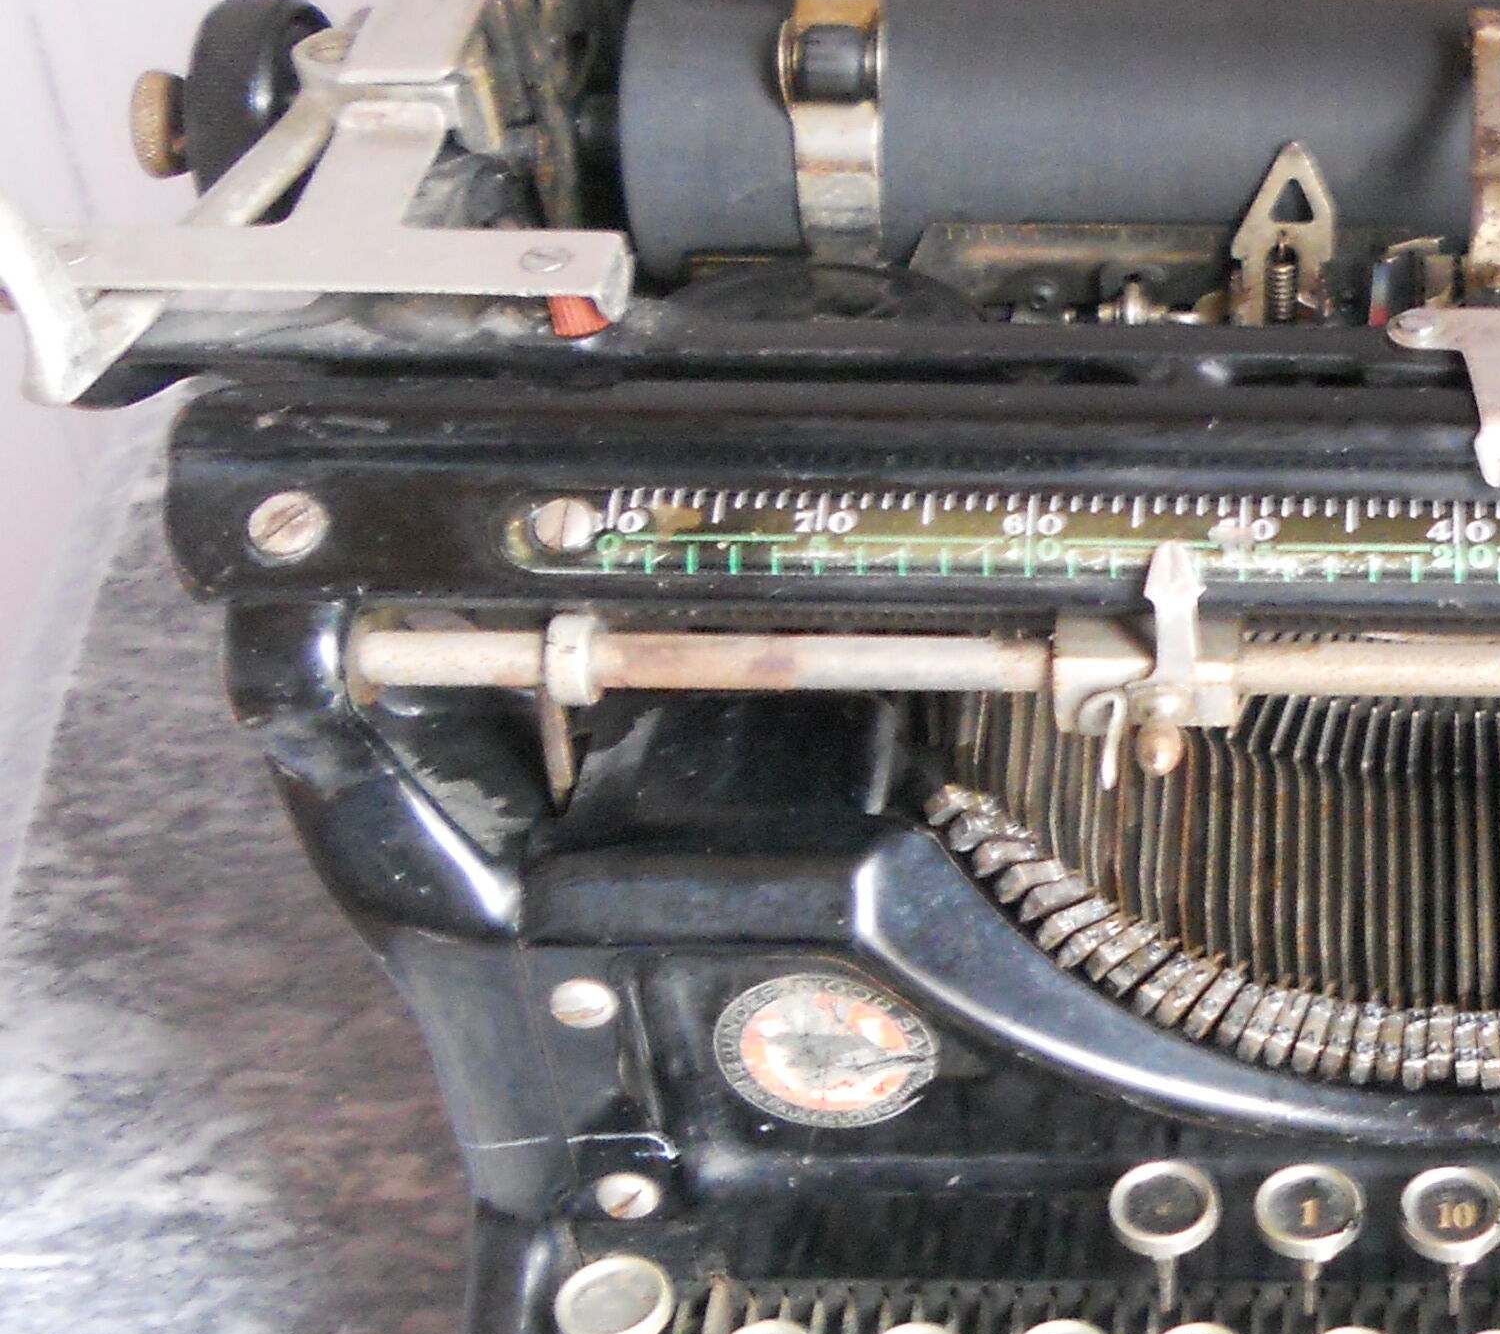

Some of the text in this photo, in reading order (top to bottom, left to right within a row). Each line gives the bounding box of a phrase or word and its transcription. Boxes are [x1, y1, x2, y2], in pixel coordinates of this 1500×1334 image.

[1003, 510, 1066, 537] 60
[1427, 517, 1496, 544] 40
[1432, 545, 1495, 568] 20
[1437, 1201, 1475, 1230] 10
